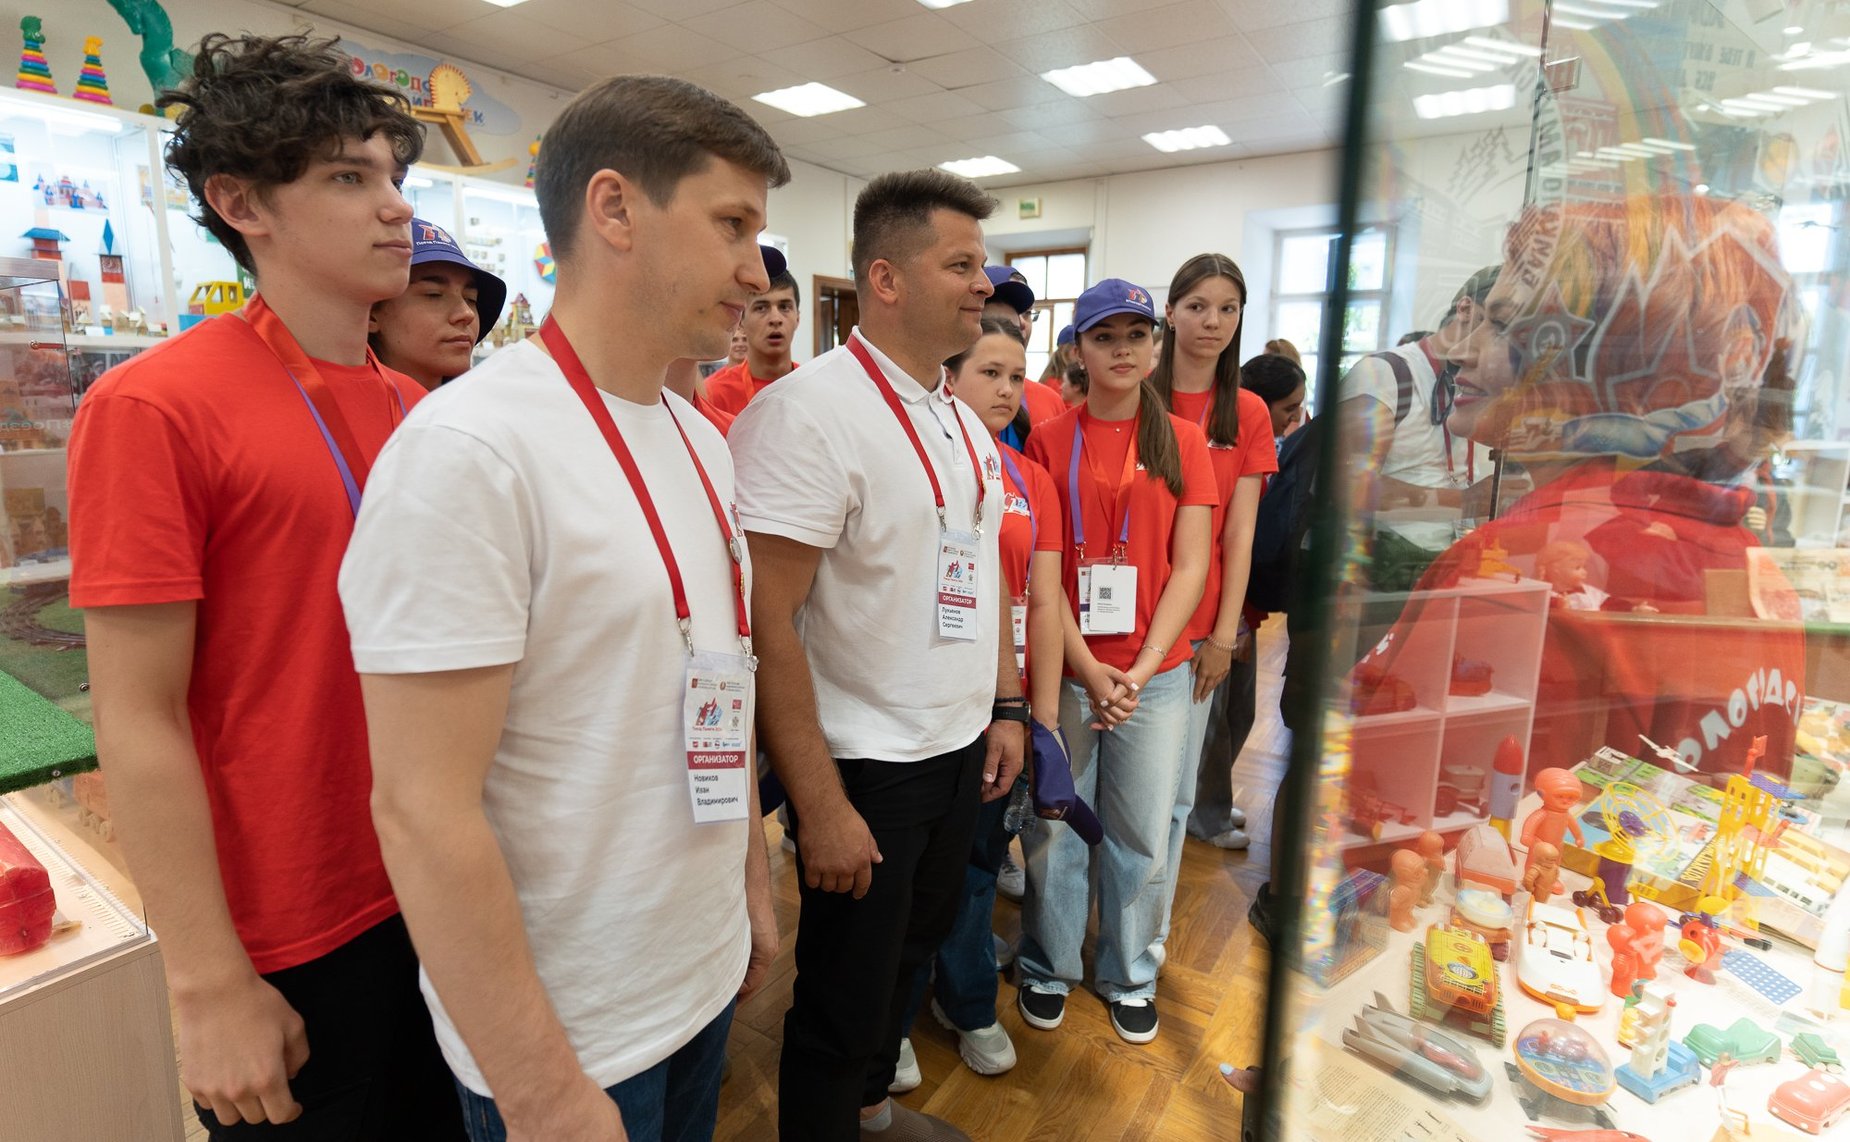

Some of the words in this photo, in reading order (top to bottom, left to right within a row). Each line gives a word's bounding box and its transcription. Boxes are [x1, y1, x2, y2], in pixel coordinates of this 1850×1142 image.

[943, 594, 973, 605] ОРГАНИЗАТОР
[693, 755, 739, 764] ОРГАНИЗАТОР
[694, 774, 719, 782] Новиков
[697, 797, 739, 807] Владимирович
